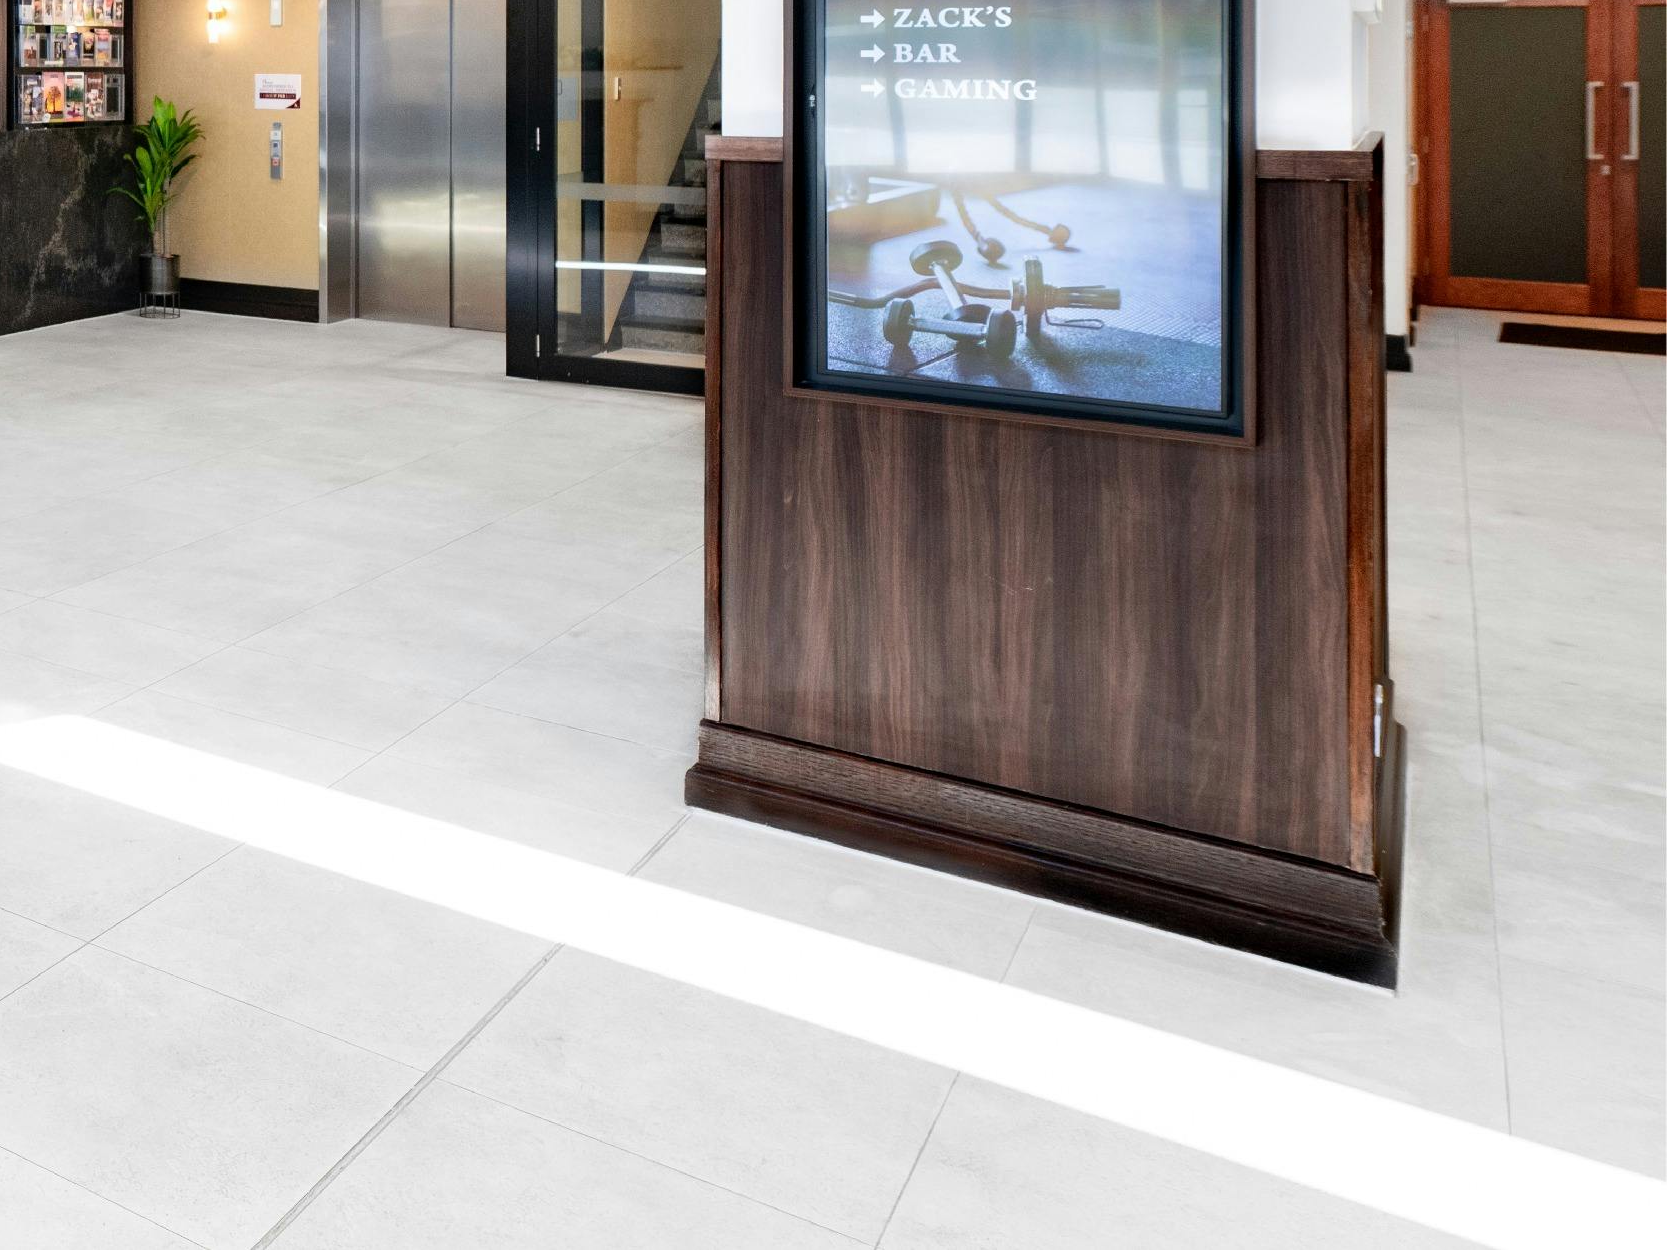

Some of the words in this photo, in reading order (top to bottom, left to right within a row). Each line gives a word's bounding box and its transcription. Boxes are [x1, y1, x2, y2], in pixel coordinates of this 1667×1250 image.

[893, 6, 1013, 29] ZACK'S
[893, 43, 962, 64] BAR
[894, 78, 1039, 101] GAMING
